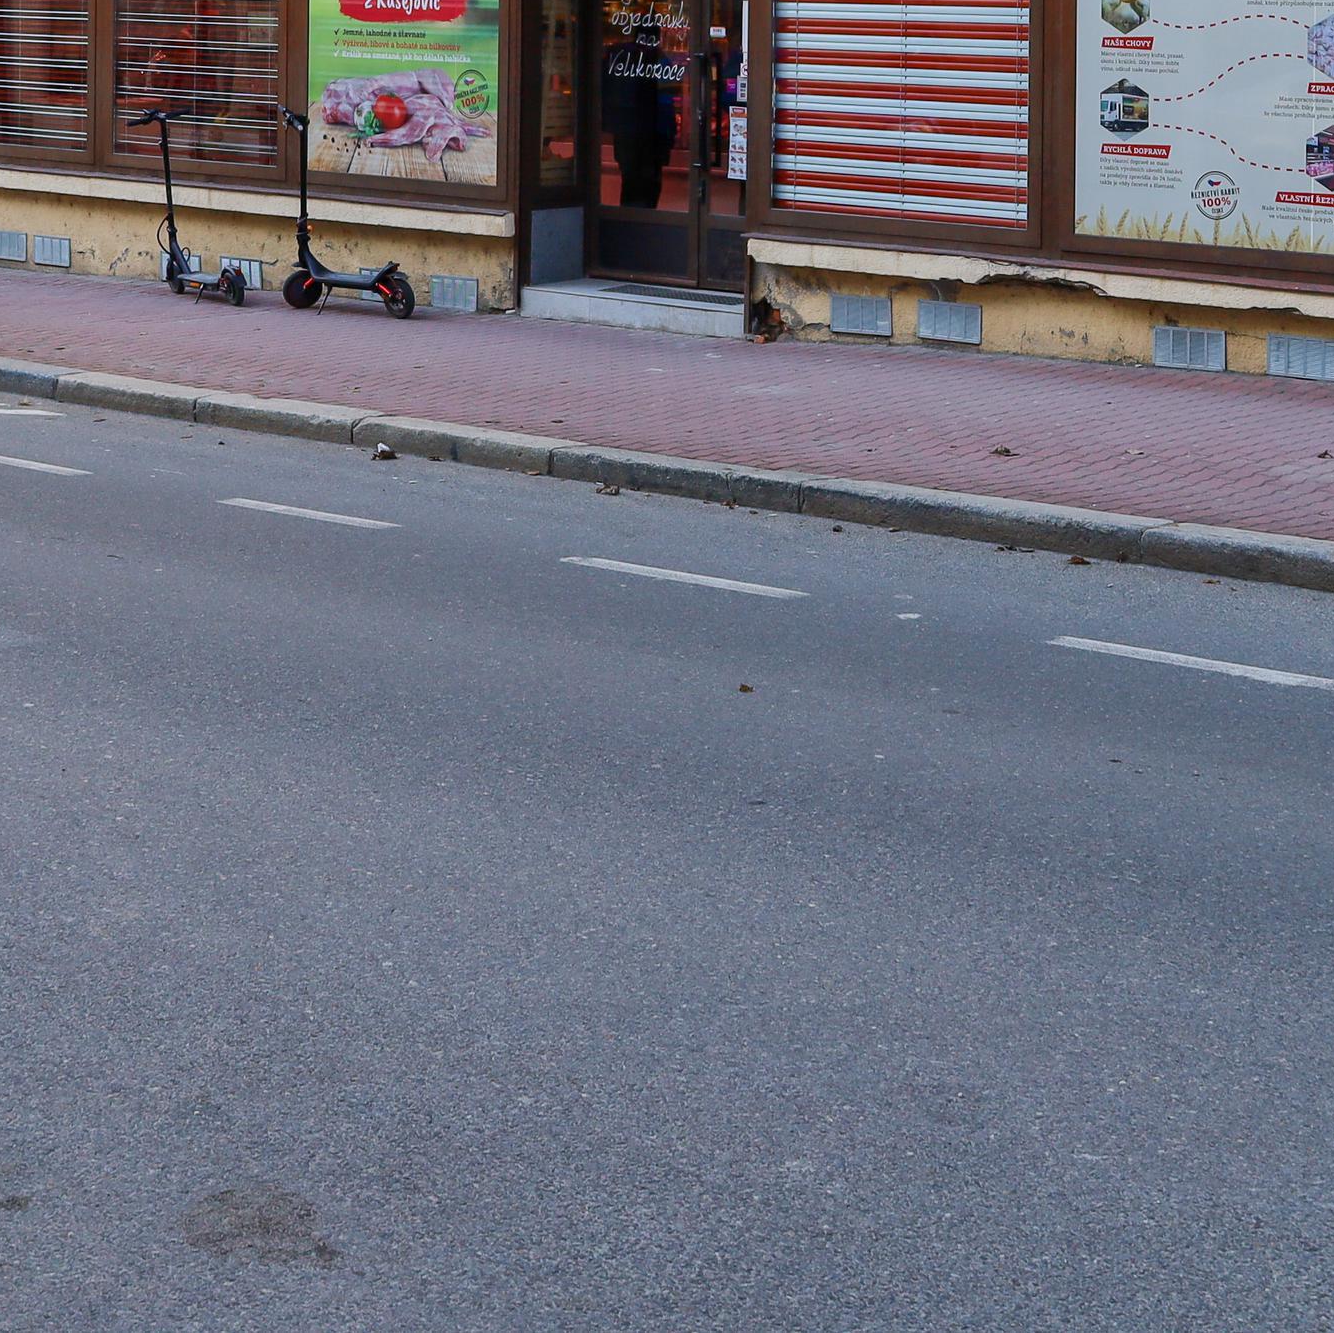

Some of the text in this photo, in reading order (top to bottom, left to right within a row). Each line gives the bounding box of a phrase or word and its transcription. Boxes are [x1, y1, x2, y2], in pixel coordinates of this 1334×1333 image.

[1104, 38, 1124, 46] NAŠE
[1134, 147, 1167, 156] DOPRAVA
[1202, 196, 1231, 208] 100%
[1279, 193, 1315, 203] VLASTNÍ
